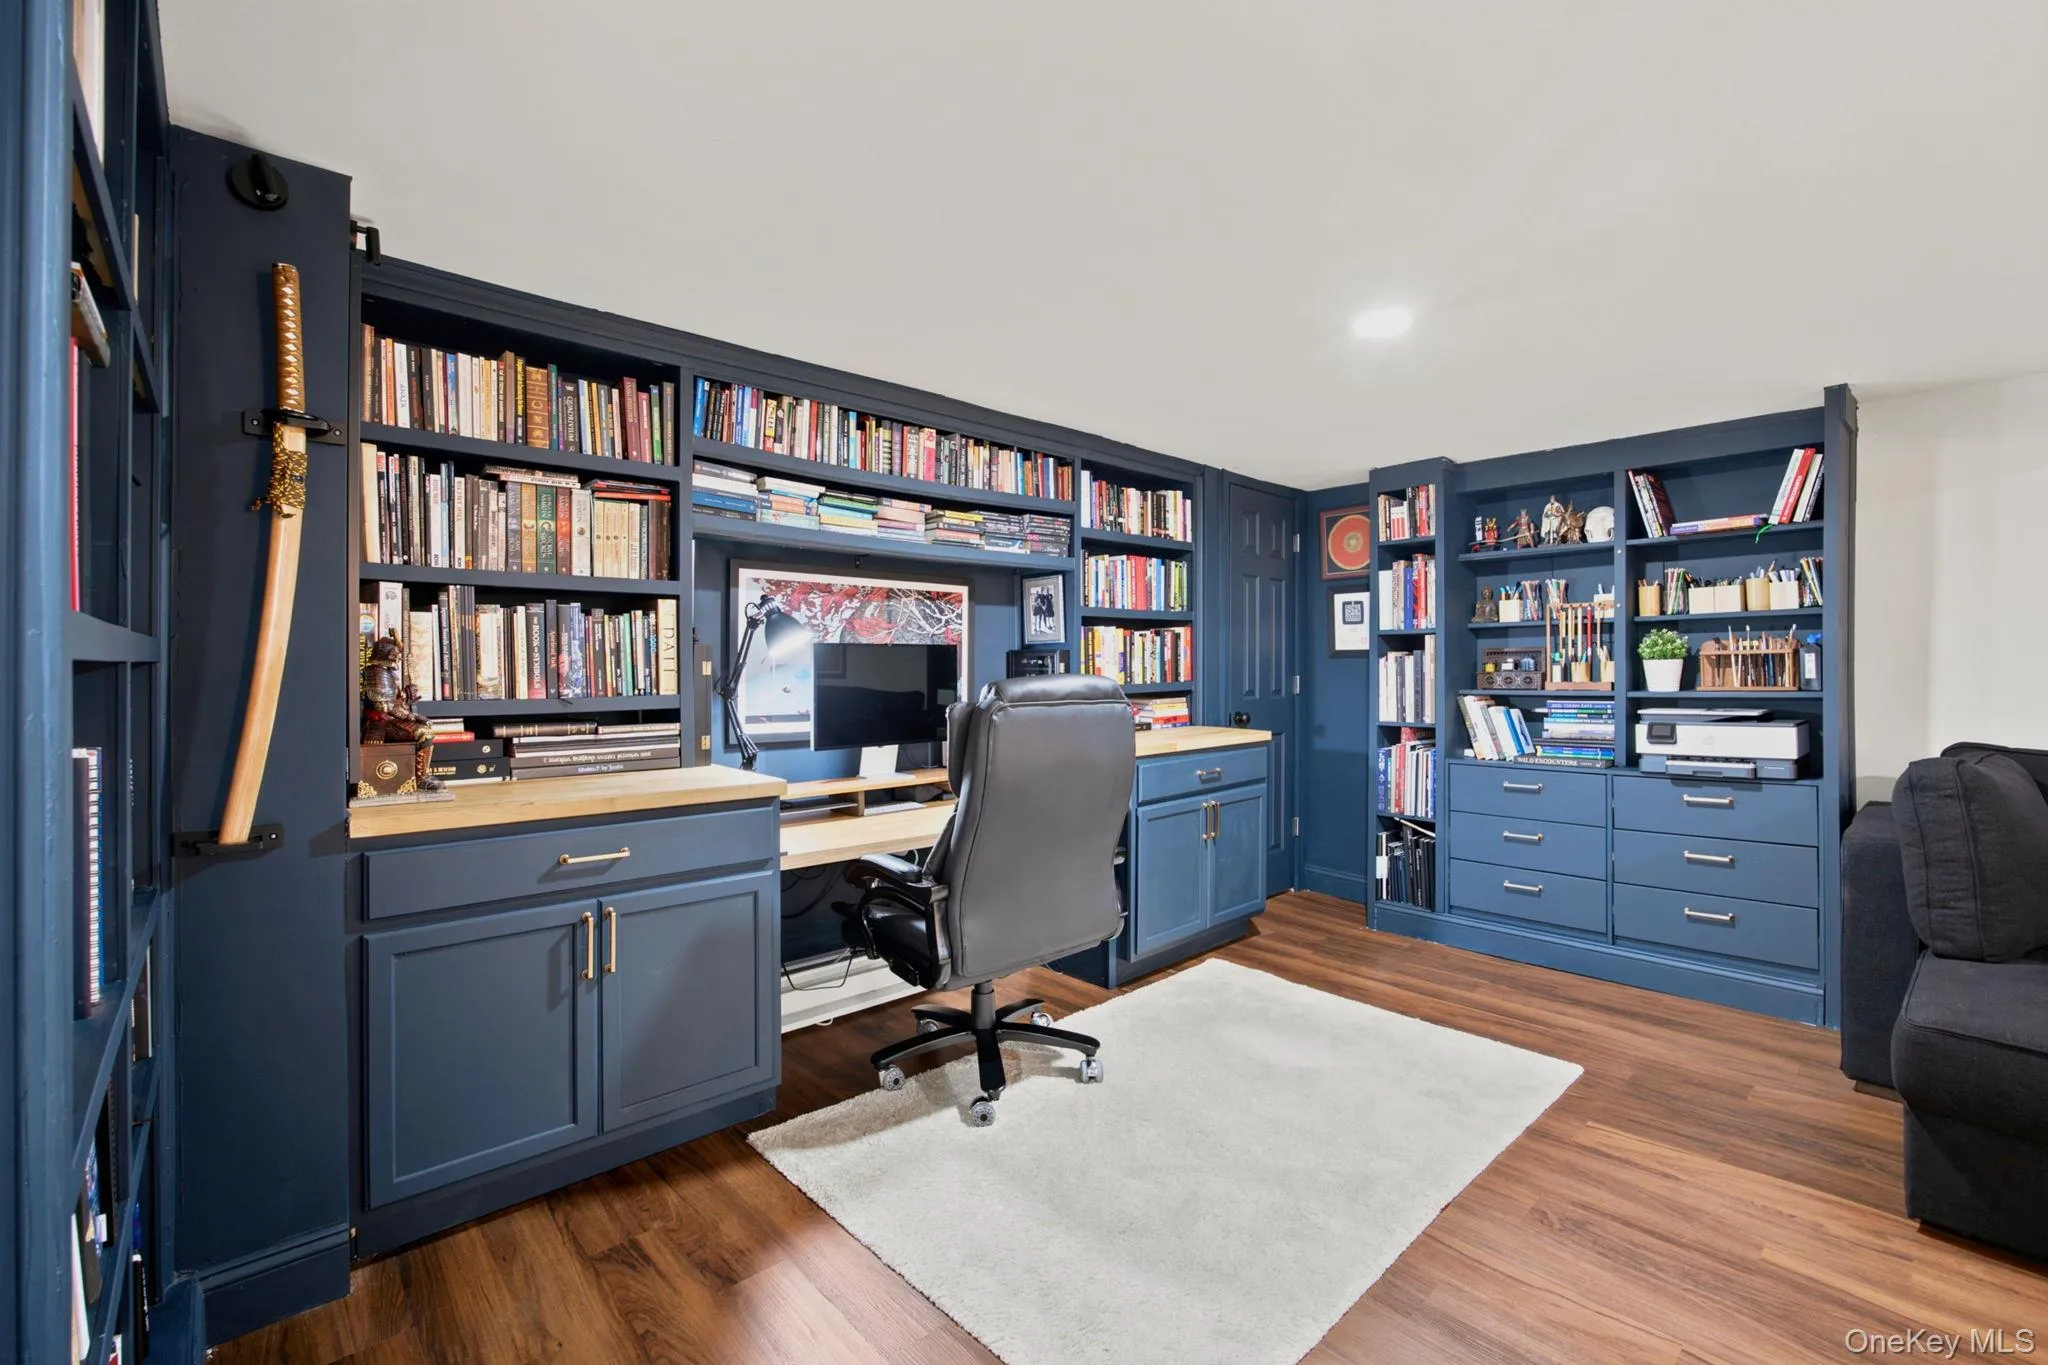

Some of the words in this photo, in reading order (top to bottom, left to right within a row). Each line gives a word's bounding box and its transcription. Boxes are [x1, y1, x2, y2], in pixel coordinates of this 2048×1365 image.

[566, 396, 575, 442] QUADRIVIUM
[532, 624, 540, 647] BOOK
[532, 652, 541, 689] SYMBOLS
[1534, 758, 1577, 766] ENCOUNTERS
